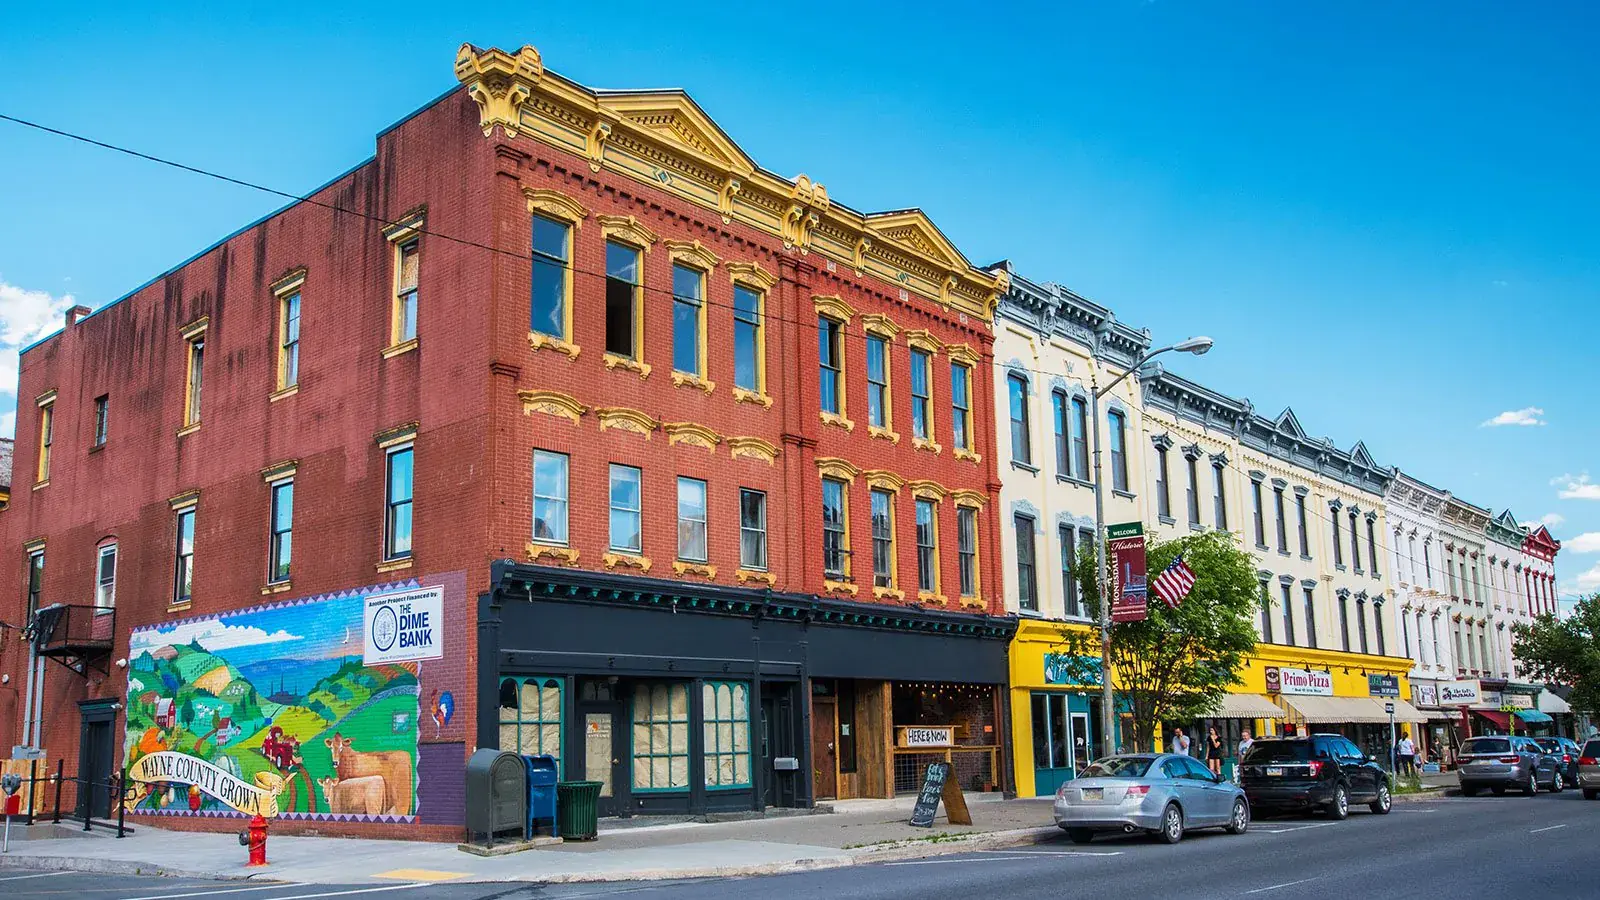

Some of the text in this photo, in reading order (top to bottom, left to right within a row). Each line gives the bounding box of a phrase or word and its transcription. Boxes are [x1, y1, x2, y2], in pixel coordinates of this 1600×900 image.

[1111, 541, 1142, 550] Historic
[1112, 552, 1120, 604] HONESDALE
[387, 596, 406, 604] Project
[407, 592, 430, 600] Financed
[399, 603, 412, 614] THE
[399, 611, 429, 631] DIME
[399, 628, 433, 648] BANK
[1283, 671, 1308, 687] Primo
[1308, 674, 1330, 688] Pizza
[141, 756, 261, 813] WAYNE COUNTY GROWN
